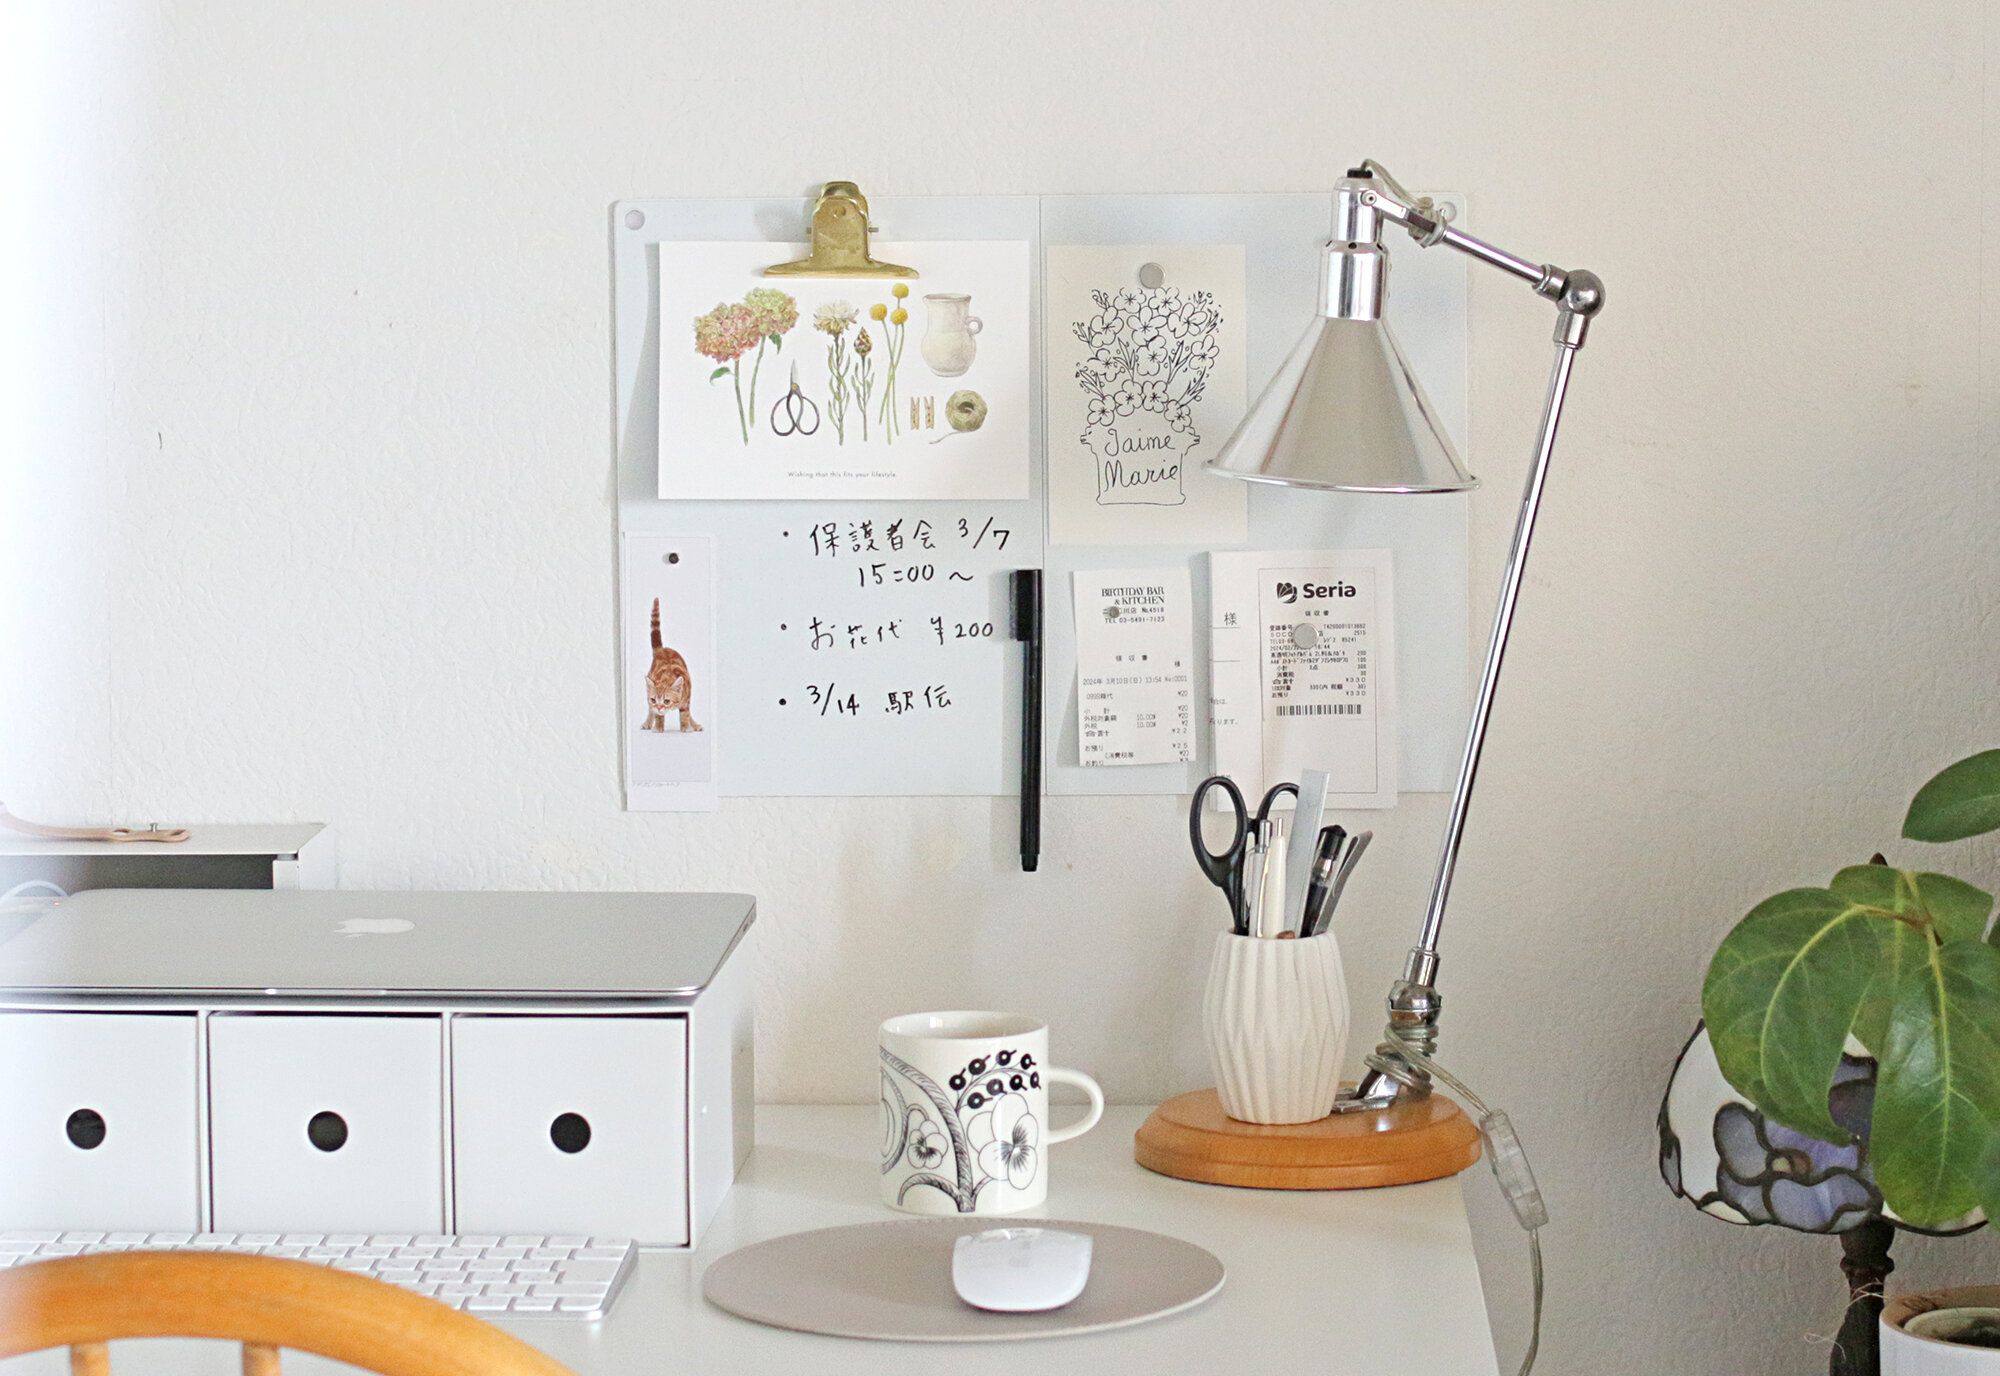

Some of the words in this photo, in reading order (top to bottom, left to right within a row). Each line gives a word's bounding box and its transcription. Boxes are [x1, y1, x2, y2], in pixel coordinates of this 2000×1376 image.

[1105, 428, 1176, 457] Jaime
[787, 470, 813, 479] Wishing
[843, 470, 853, 478] fits
[1104, 459, 1178, 492] Marie
[809, 518, 936, 557] 保護者会
[958, 516, 1010, 550] 3/7
[1101, 587, 1144, 597] BIRTHDAY
[1146, 586, 1165, 596] BAR
[1114, 598, 1120, 606] &
[1121, 596, 1165, 605] KITCHEN
[1302, 580, 1357, 600] Seria
[1223, 611, 1237, 627] 様
[809, 616, 903, 651] お花代
[806, 683, 860, 716] 3/14
[885, 684, 952, 715] 駅伝
